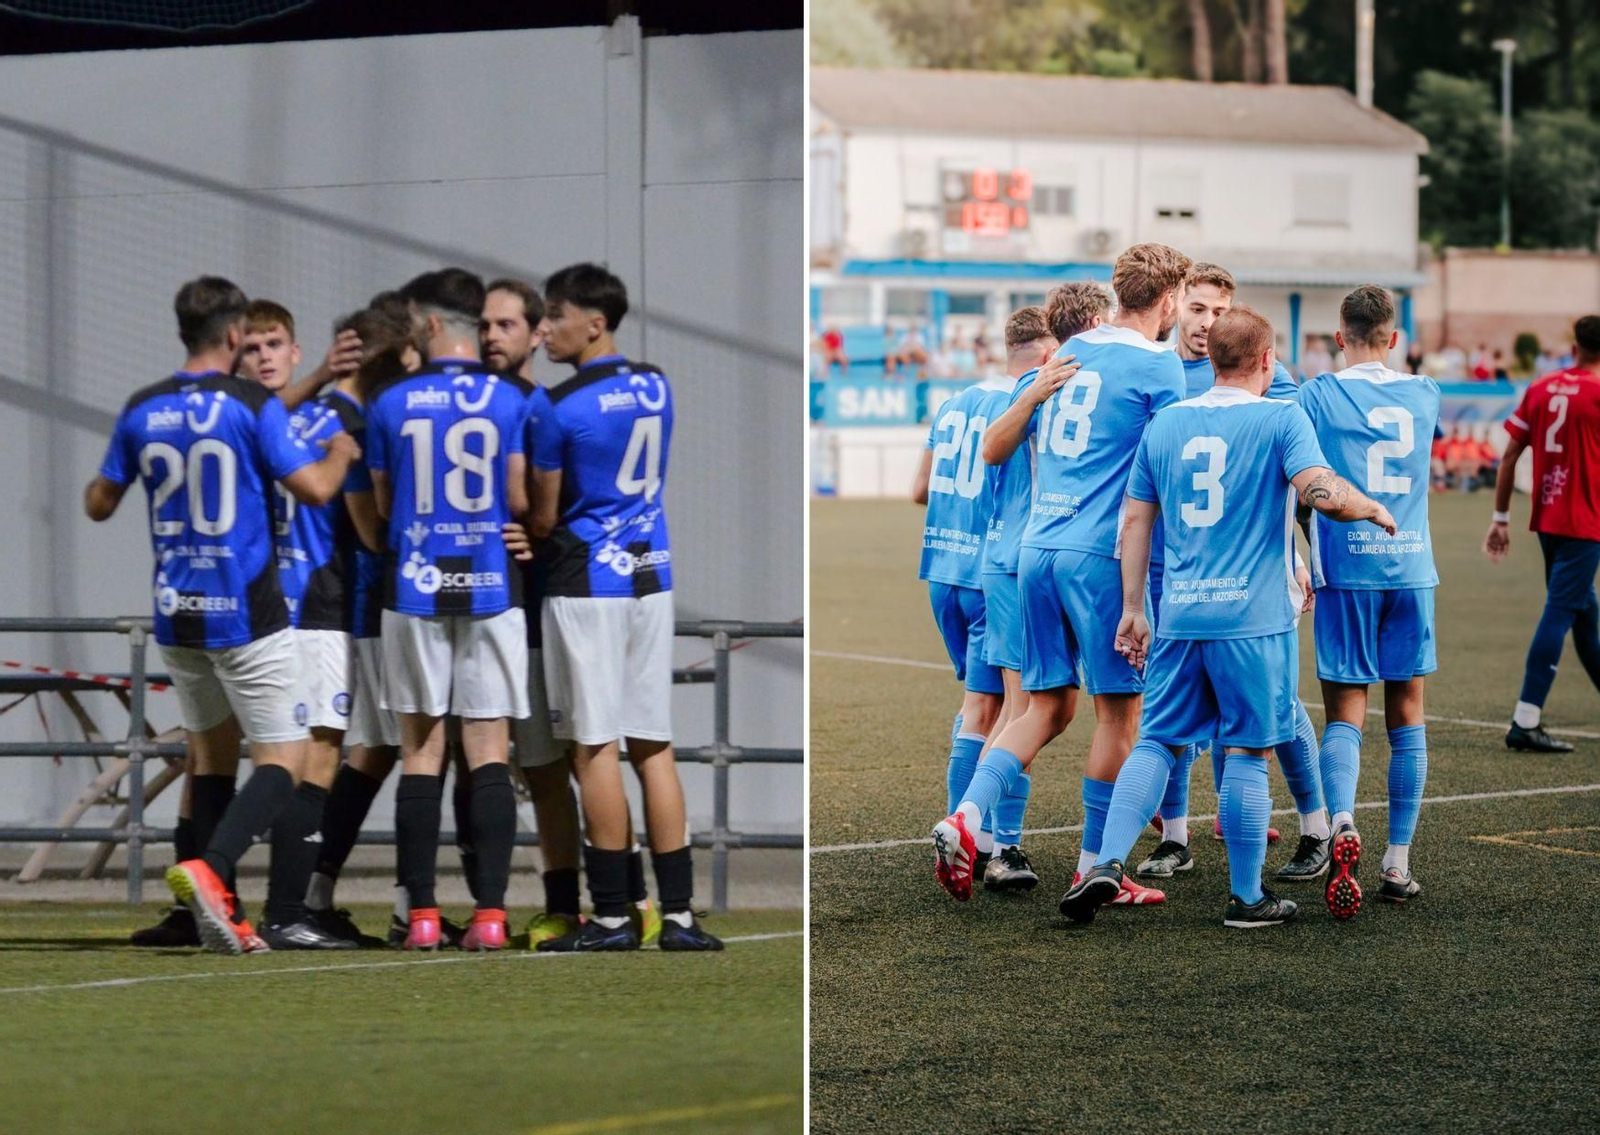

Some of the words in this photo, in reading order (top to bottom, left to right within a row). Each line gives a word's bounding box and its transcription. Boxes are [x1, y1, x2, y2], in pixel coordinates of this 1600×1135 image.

[838, 386, 906, 418] SAN
[1036, 370, 1102, 459] 18
[1545, 394, 1569, 453] 2
[139, 439, 236, 536] 20
[400, 417, 499, 514] 18
[616, 415, 662, 504] 4
[928, 410, 988, 500] 20
[1181, 436, 1228, 527] 3
[1367, 406, 1415, 494] 2
[1211, 590, 1248, 601] ARZOBISPO
[1239, 576, 1248, 586] DE
